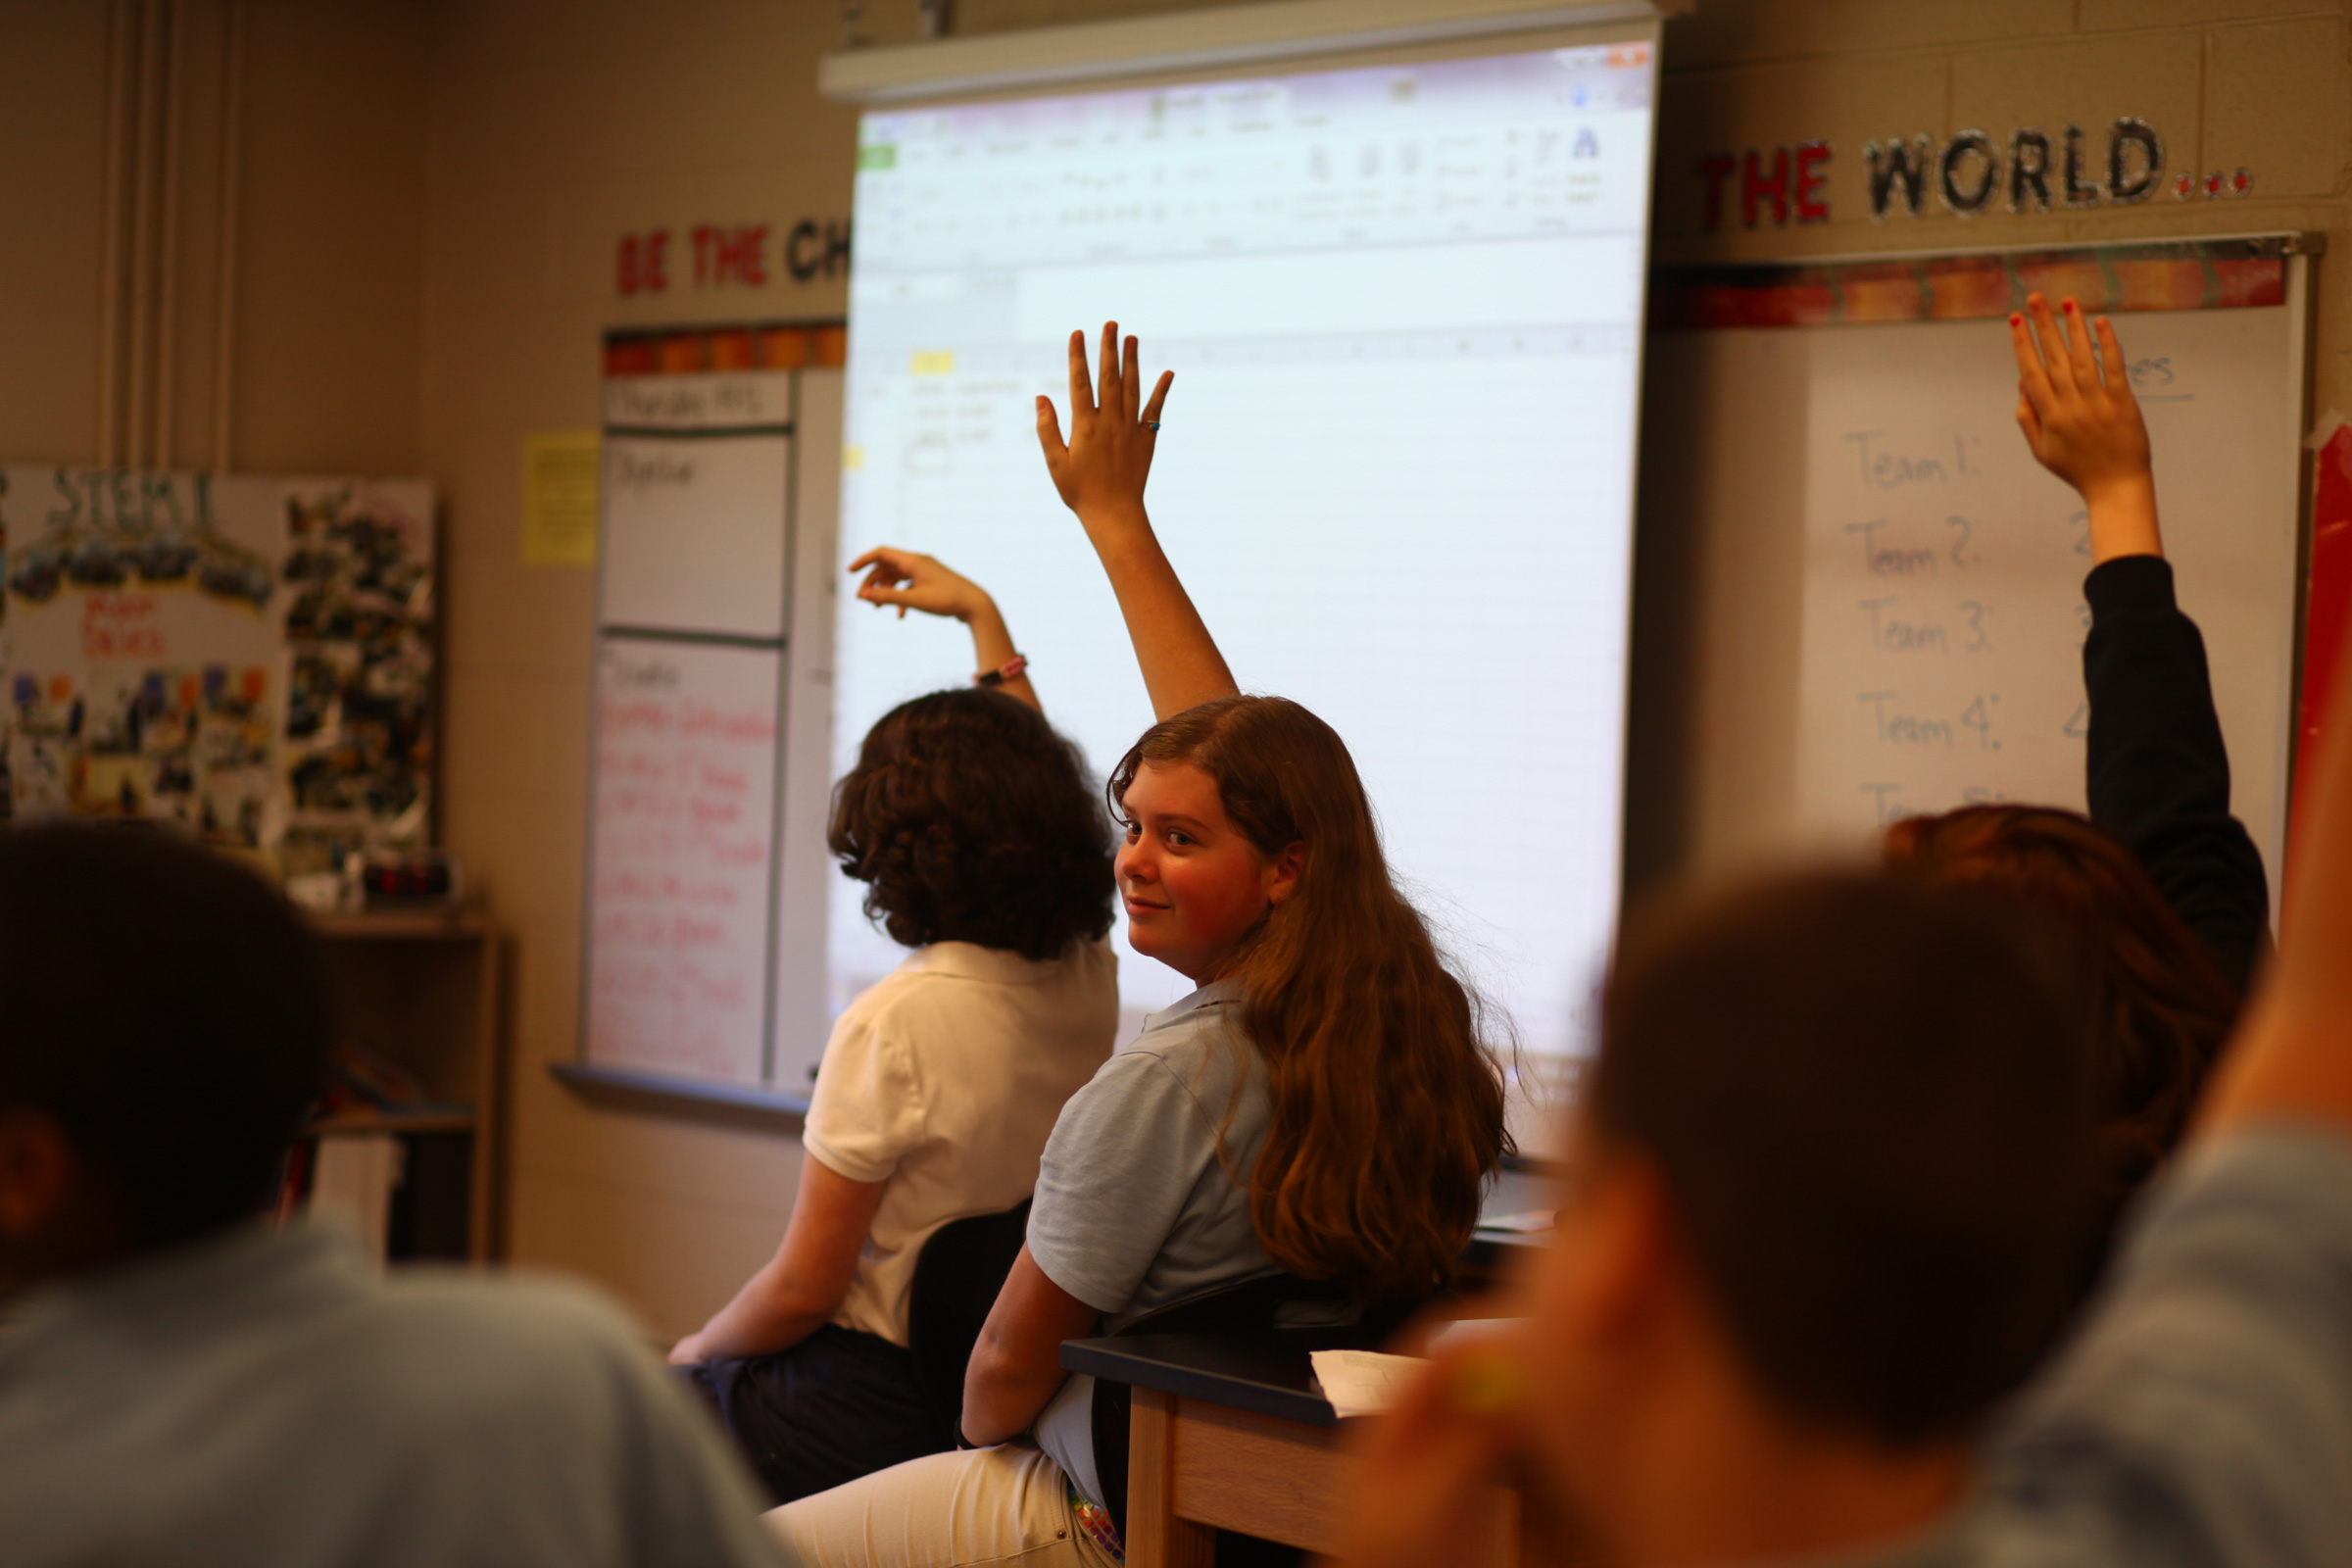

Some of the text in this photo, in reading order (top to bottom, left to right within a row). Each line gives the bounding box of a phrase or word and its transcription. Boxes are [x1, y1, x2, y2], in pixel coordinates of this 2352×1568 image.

[1696, 139, 1835, 230] THE
[616, 228, 669, 298] BE
[691, 223, 768, 287] THE
[1843, 431, 1946, 487] Team
[47, 466, 184, 530] STEM
[1844, 519, 1937, 576] Team
[1858, 596, 1950, 653] Team
[1857, 690, 1954, 747] Team
